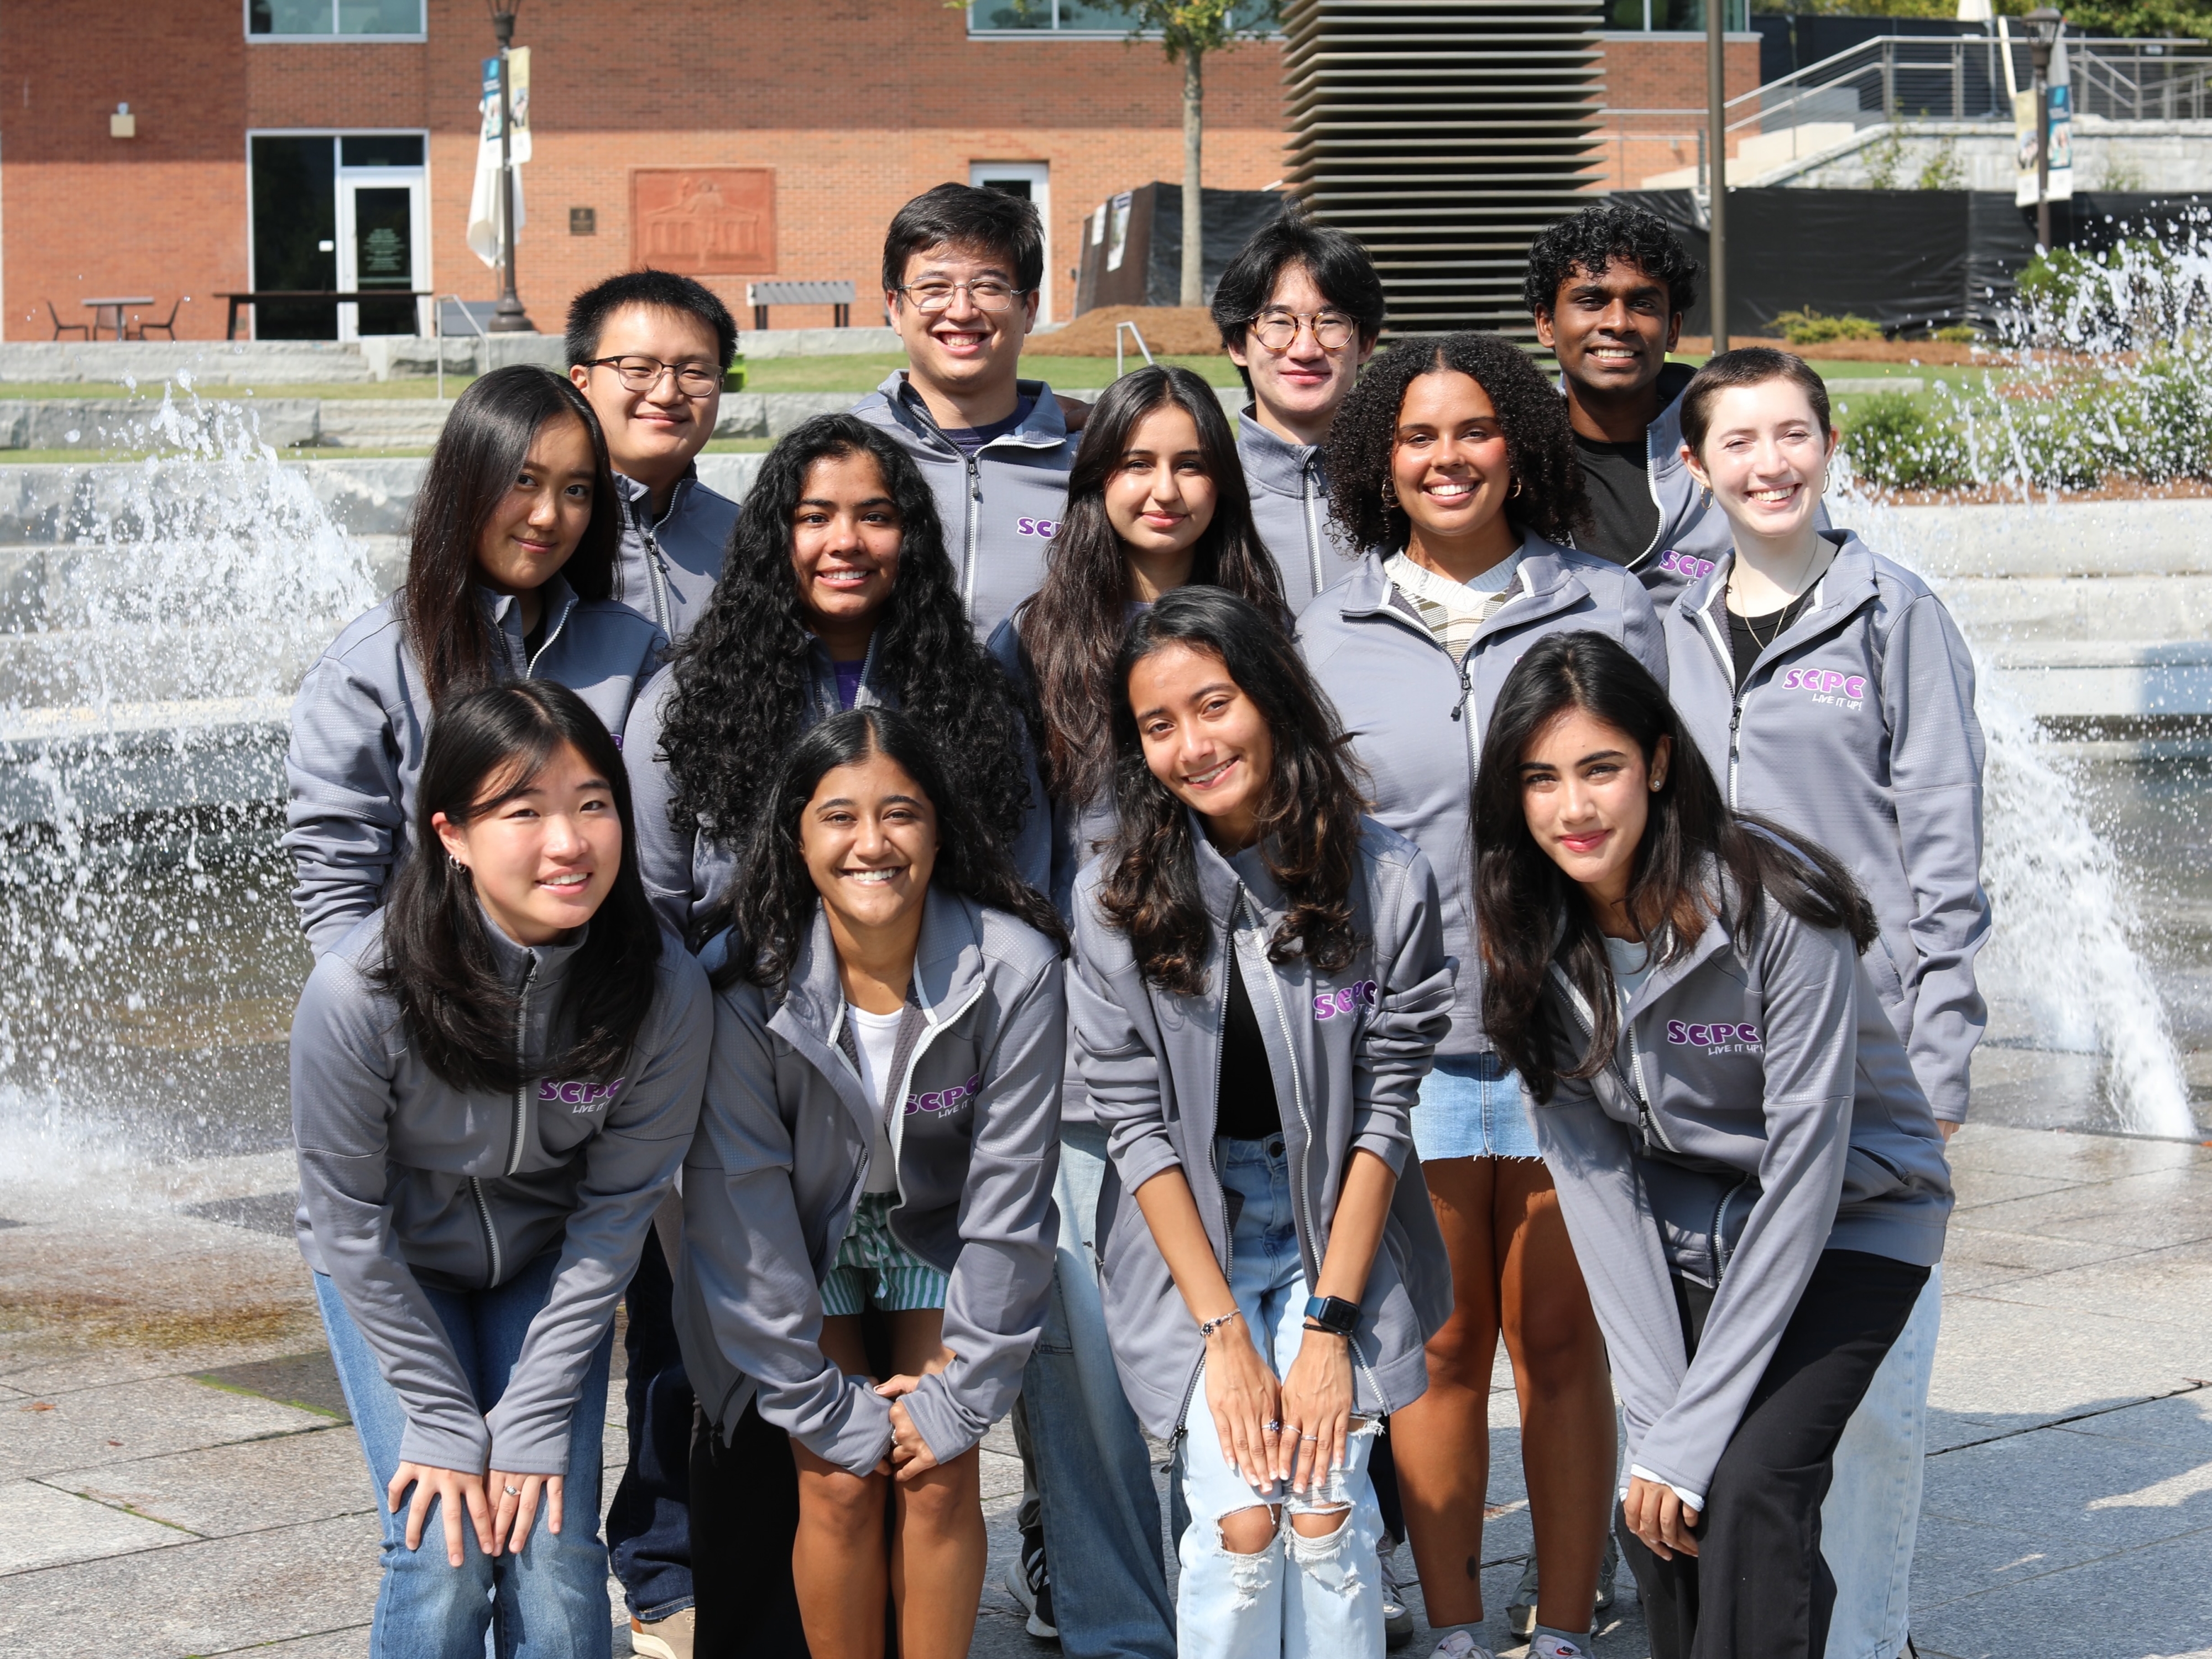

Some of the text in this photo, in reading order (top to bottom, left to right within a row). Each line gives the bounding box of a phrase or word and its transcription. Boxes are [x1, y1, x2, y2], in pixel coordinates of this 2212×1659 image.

[1782, 668, 1867, 699] SCPC
[1812, 693, 1863, 711] LIVE IT UP!
[1667, 1019, 1761, 1046] SCPC
[1708, 1044, 1764, 1056] LIVE IT UP!
[572, 1101, 607, 1114] LIVE IT
[938, 1098, 969, 1119] LIVE IT
